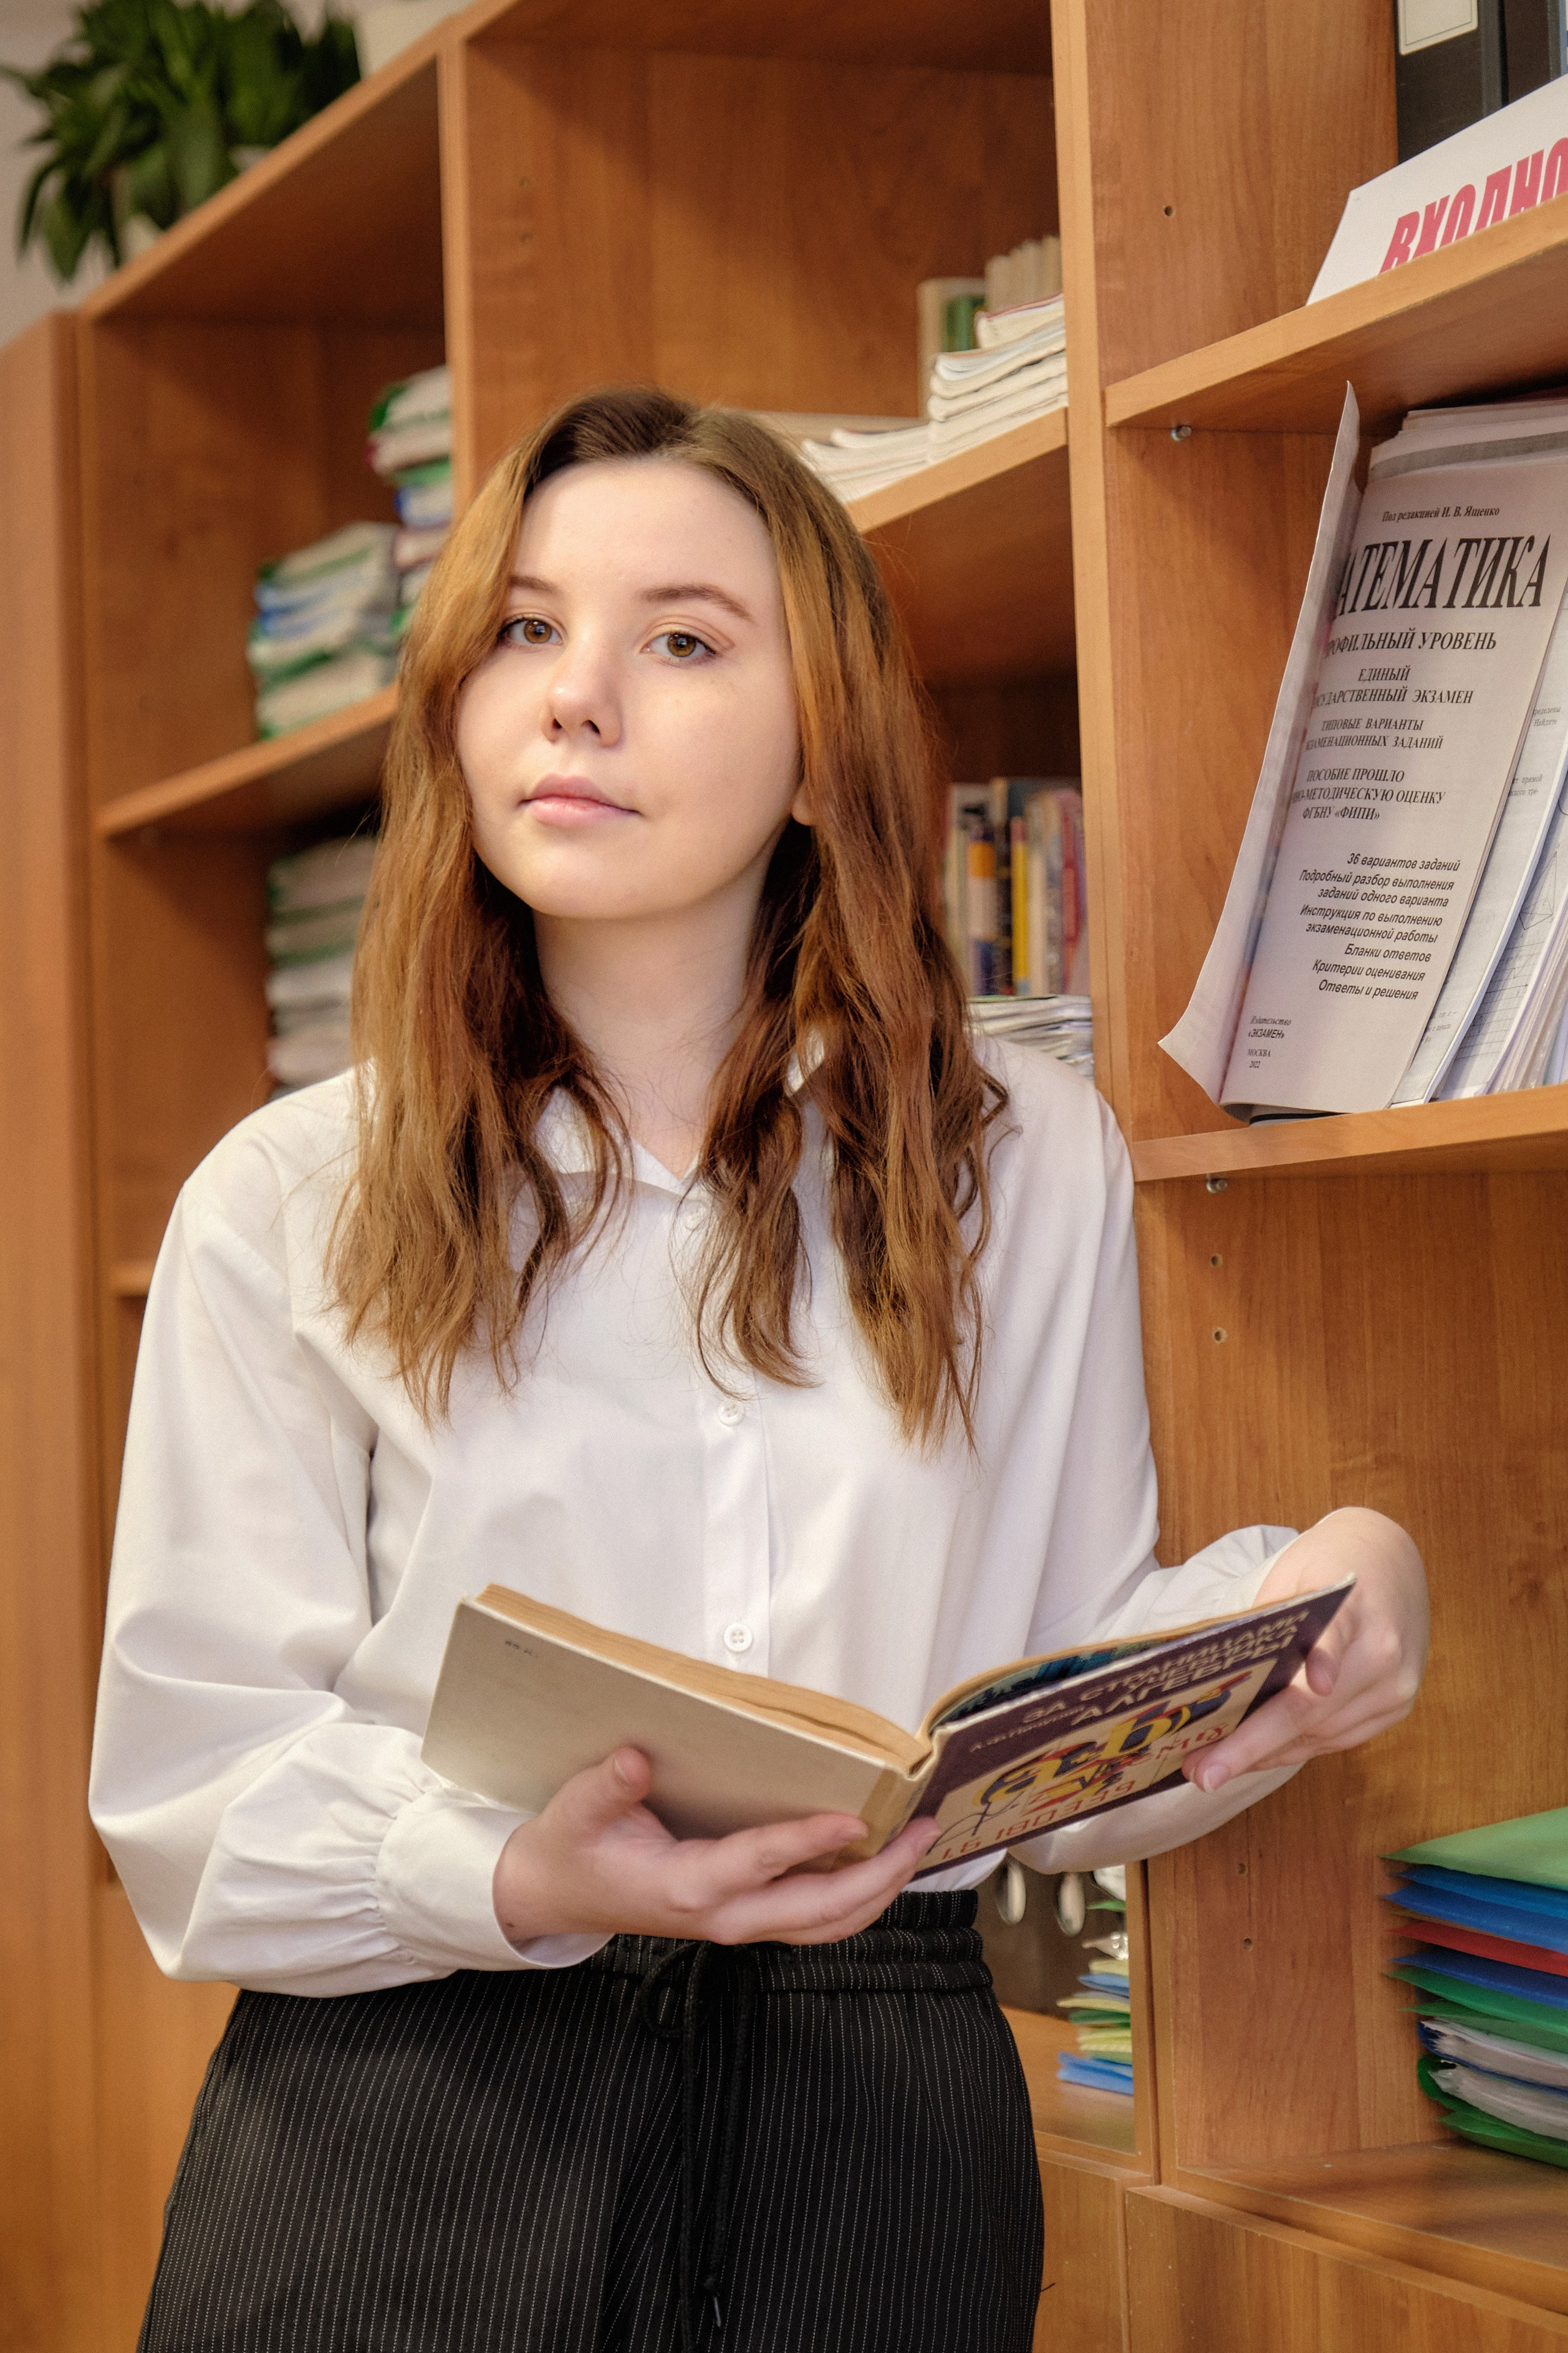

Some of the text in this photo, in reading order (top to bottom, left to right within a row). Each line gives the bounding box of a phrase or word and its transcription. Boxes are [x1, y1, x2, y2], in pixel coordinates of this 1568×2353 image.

[1382, 506, 1499, 522] Под редакцией И. В. Ященко
[1325, 627, 1497, 658] РОФИЛЬНЫЙ УРОВЕНЬ
[1357, 665, 1411, 682] ЕДИНЫЙ
[1412, 689, 1473, 704] ЭКЗАМЕН
[1322, 718, 1425, 731] ТИПОВЫЕ ВАРИАНТЫ
[1392, 735, 1443, 749] ЗАДАНИЙ
[1306, 768, 1405, 782] ПОСОБИЕ ПРОШЛО
[1396, 790, 1446, 804] ОЦЕНКУ
[1302, 806, 1380, 820] ФГБНУ «ФИПИ»
[1347, 853, 1461, 872] 36 вариантов заданий
[1299, 869, 1455, 890] Подробный разбор выполнения
[1317, 887, 1449, 908] заданий одного варианта
[1299, 904, 1443, 926] Инструкция по выполнению
[1306, 923, 1438, 943] экзаменационной работы
[1344, 943, 1431, 963] Бланки ответов
[1312, 959, 1426, 981] Критерии оценивания
[1319, 979, 1418, 1000] Ответы и решения
[1069, 1633, 1296, 1726] АЛГЕБРЫ
[1023, 1700, 1066, 1724] ЗА
